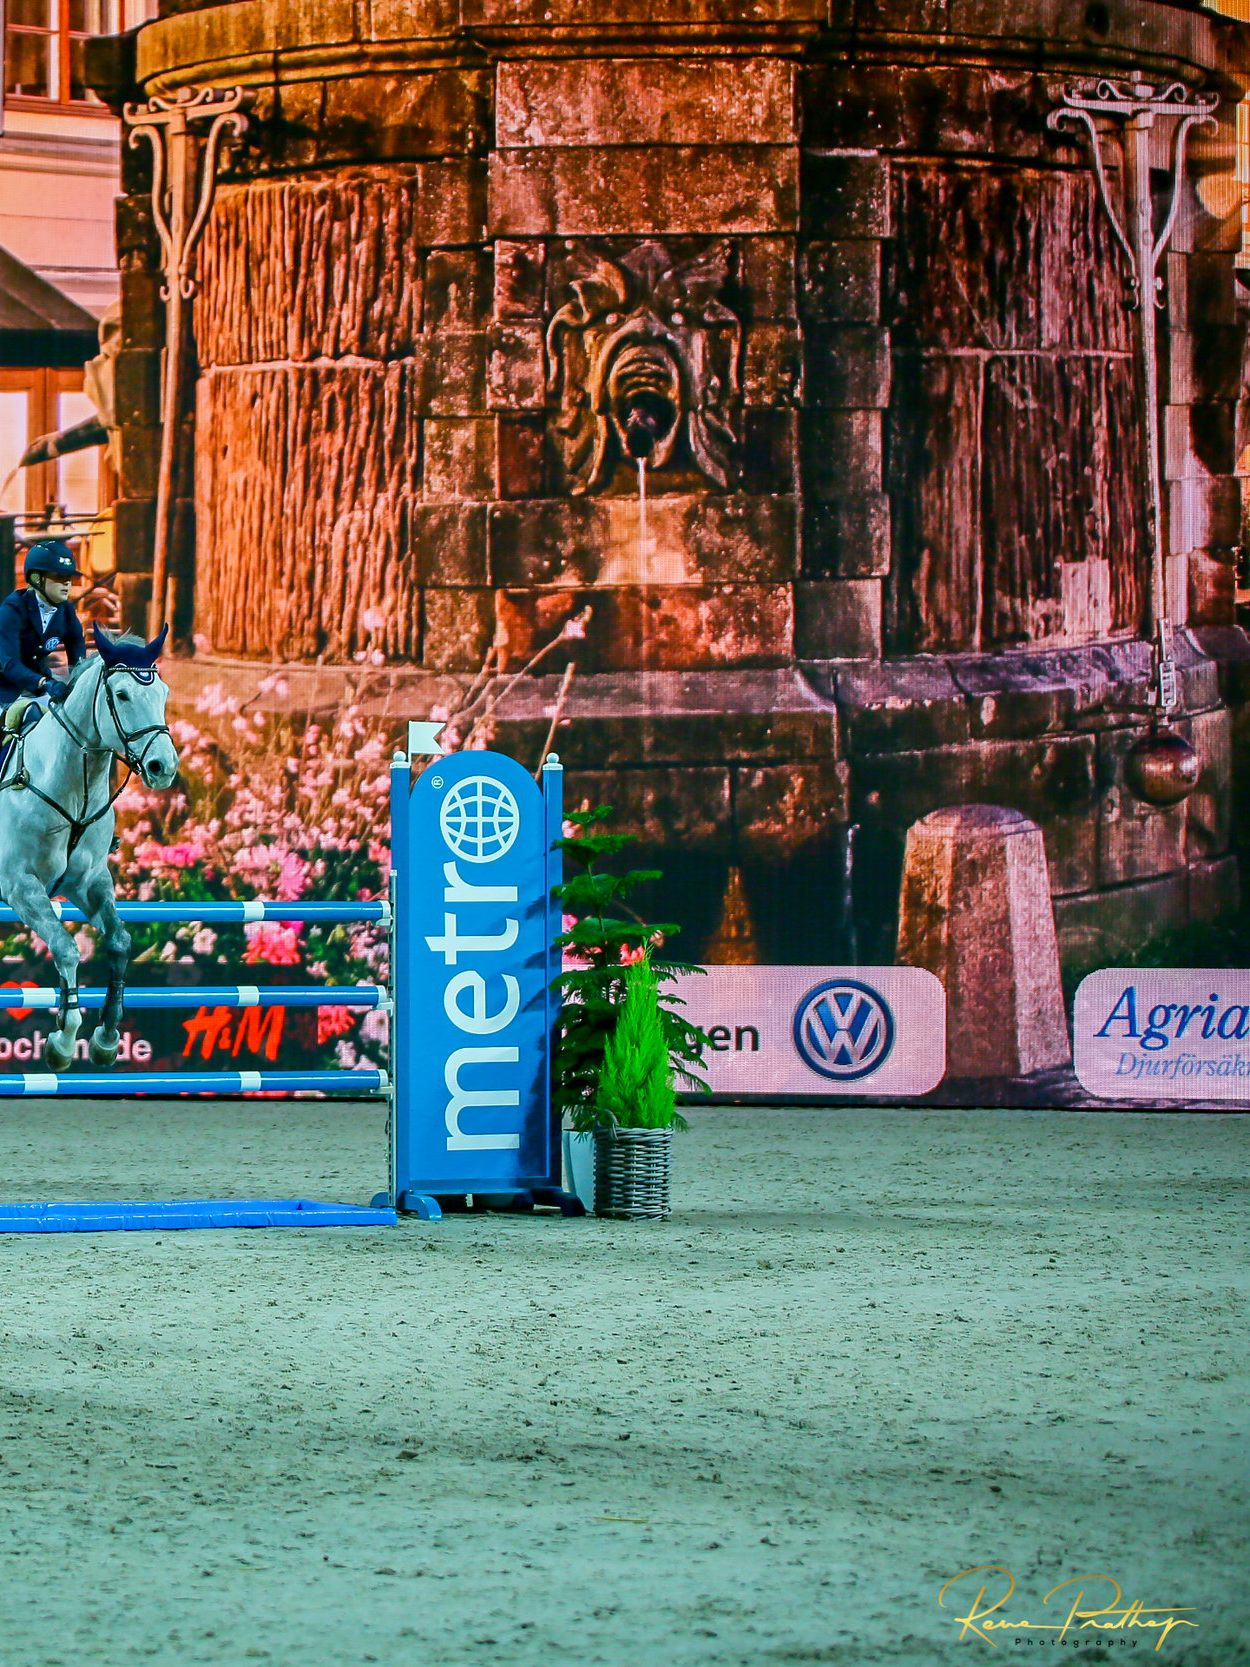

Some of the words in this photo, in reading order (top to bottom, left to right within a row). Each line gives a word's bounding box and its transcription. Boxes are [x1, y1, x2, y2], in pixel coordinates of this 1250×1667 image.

[424, 775, 520, 1151] metro
[182, 1005, 285, 1061] H&M
[1093, 986, 1250, 1051] Agria
